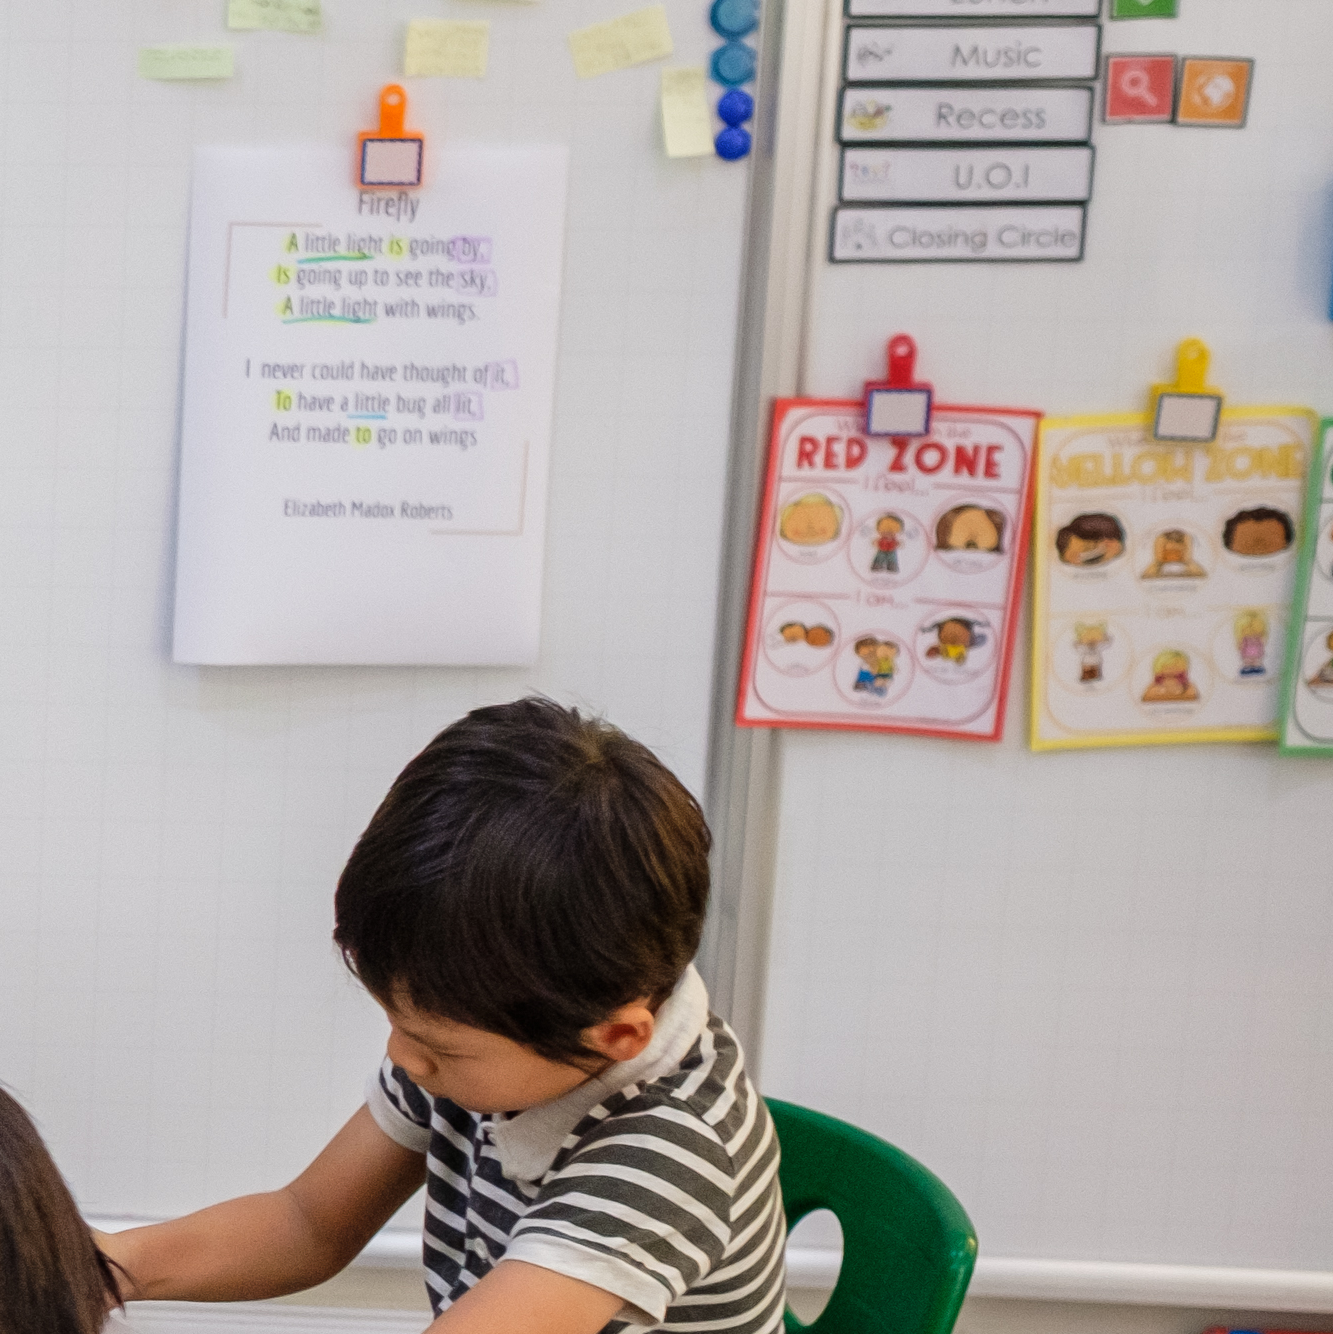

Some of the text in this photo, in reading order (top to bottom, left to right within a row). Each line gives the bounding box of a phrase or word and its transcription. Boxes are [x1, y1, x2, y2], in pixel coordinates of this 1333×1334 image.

[951, 42, 1043, 69] Music
[936, 103, 1046, 130] Recess
[954, 162, 1031, 190] U.O.I
[358, 191, 420, 222] Firefly
[287, 233, 299, 253] A
[304, 234, 341, 253] little
[346, 234, 384, 257] light
[388, 238, 403, 254] is
[409, 238, 455, 260] going
[889, 222, 1077, 253] Closing Circle
[276, 265, 290, 284] Is
[296, 267, 343, 289] going
[348, 269, 368, 289] up
[373, 268, 389, 286] to
[396, 270, 423, 286] see
[428, 269, 454, 287] the
[283, 296, 294, 315] A
[299, 297, 336, 316] little
[341, 298, 378, 322] light
[384, 299, 421, 318] with
[261, 362, 305, 380] never
[311, 361, 355, 381] could
[360, 362, 398, 382] have
[403, 362, 468, 387] thought
[473, 364, 490, 386] of
[275, 390, 292, 411] To
[297, 392, 334, 412] have
[340, 396, 349, 412] a
[354, 393, 390, 413] little
[396, 393, 426, 419] bug
[433, 393, 451, 415] all
[269, 422, 300, 443] And
[306, 423, 351, 443] made
[355, 426, 372, 444] to
[378, 429, 398, 450] go
[403, 429, 422, 444] on
[797, 435, 1004, 479] RED ZONE
[283, 499, 346, 518] Elizabeth
[400, 501, 453, 520] Roberts
